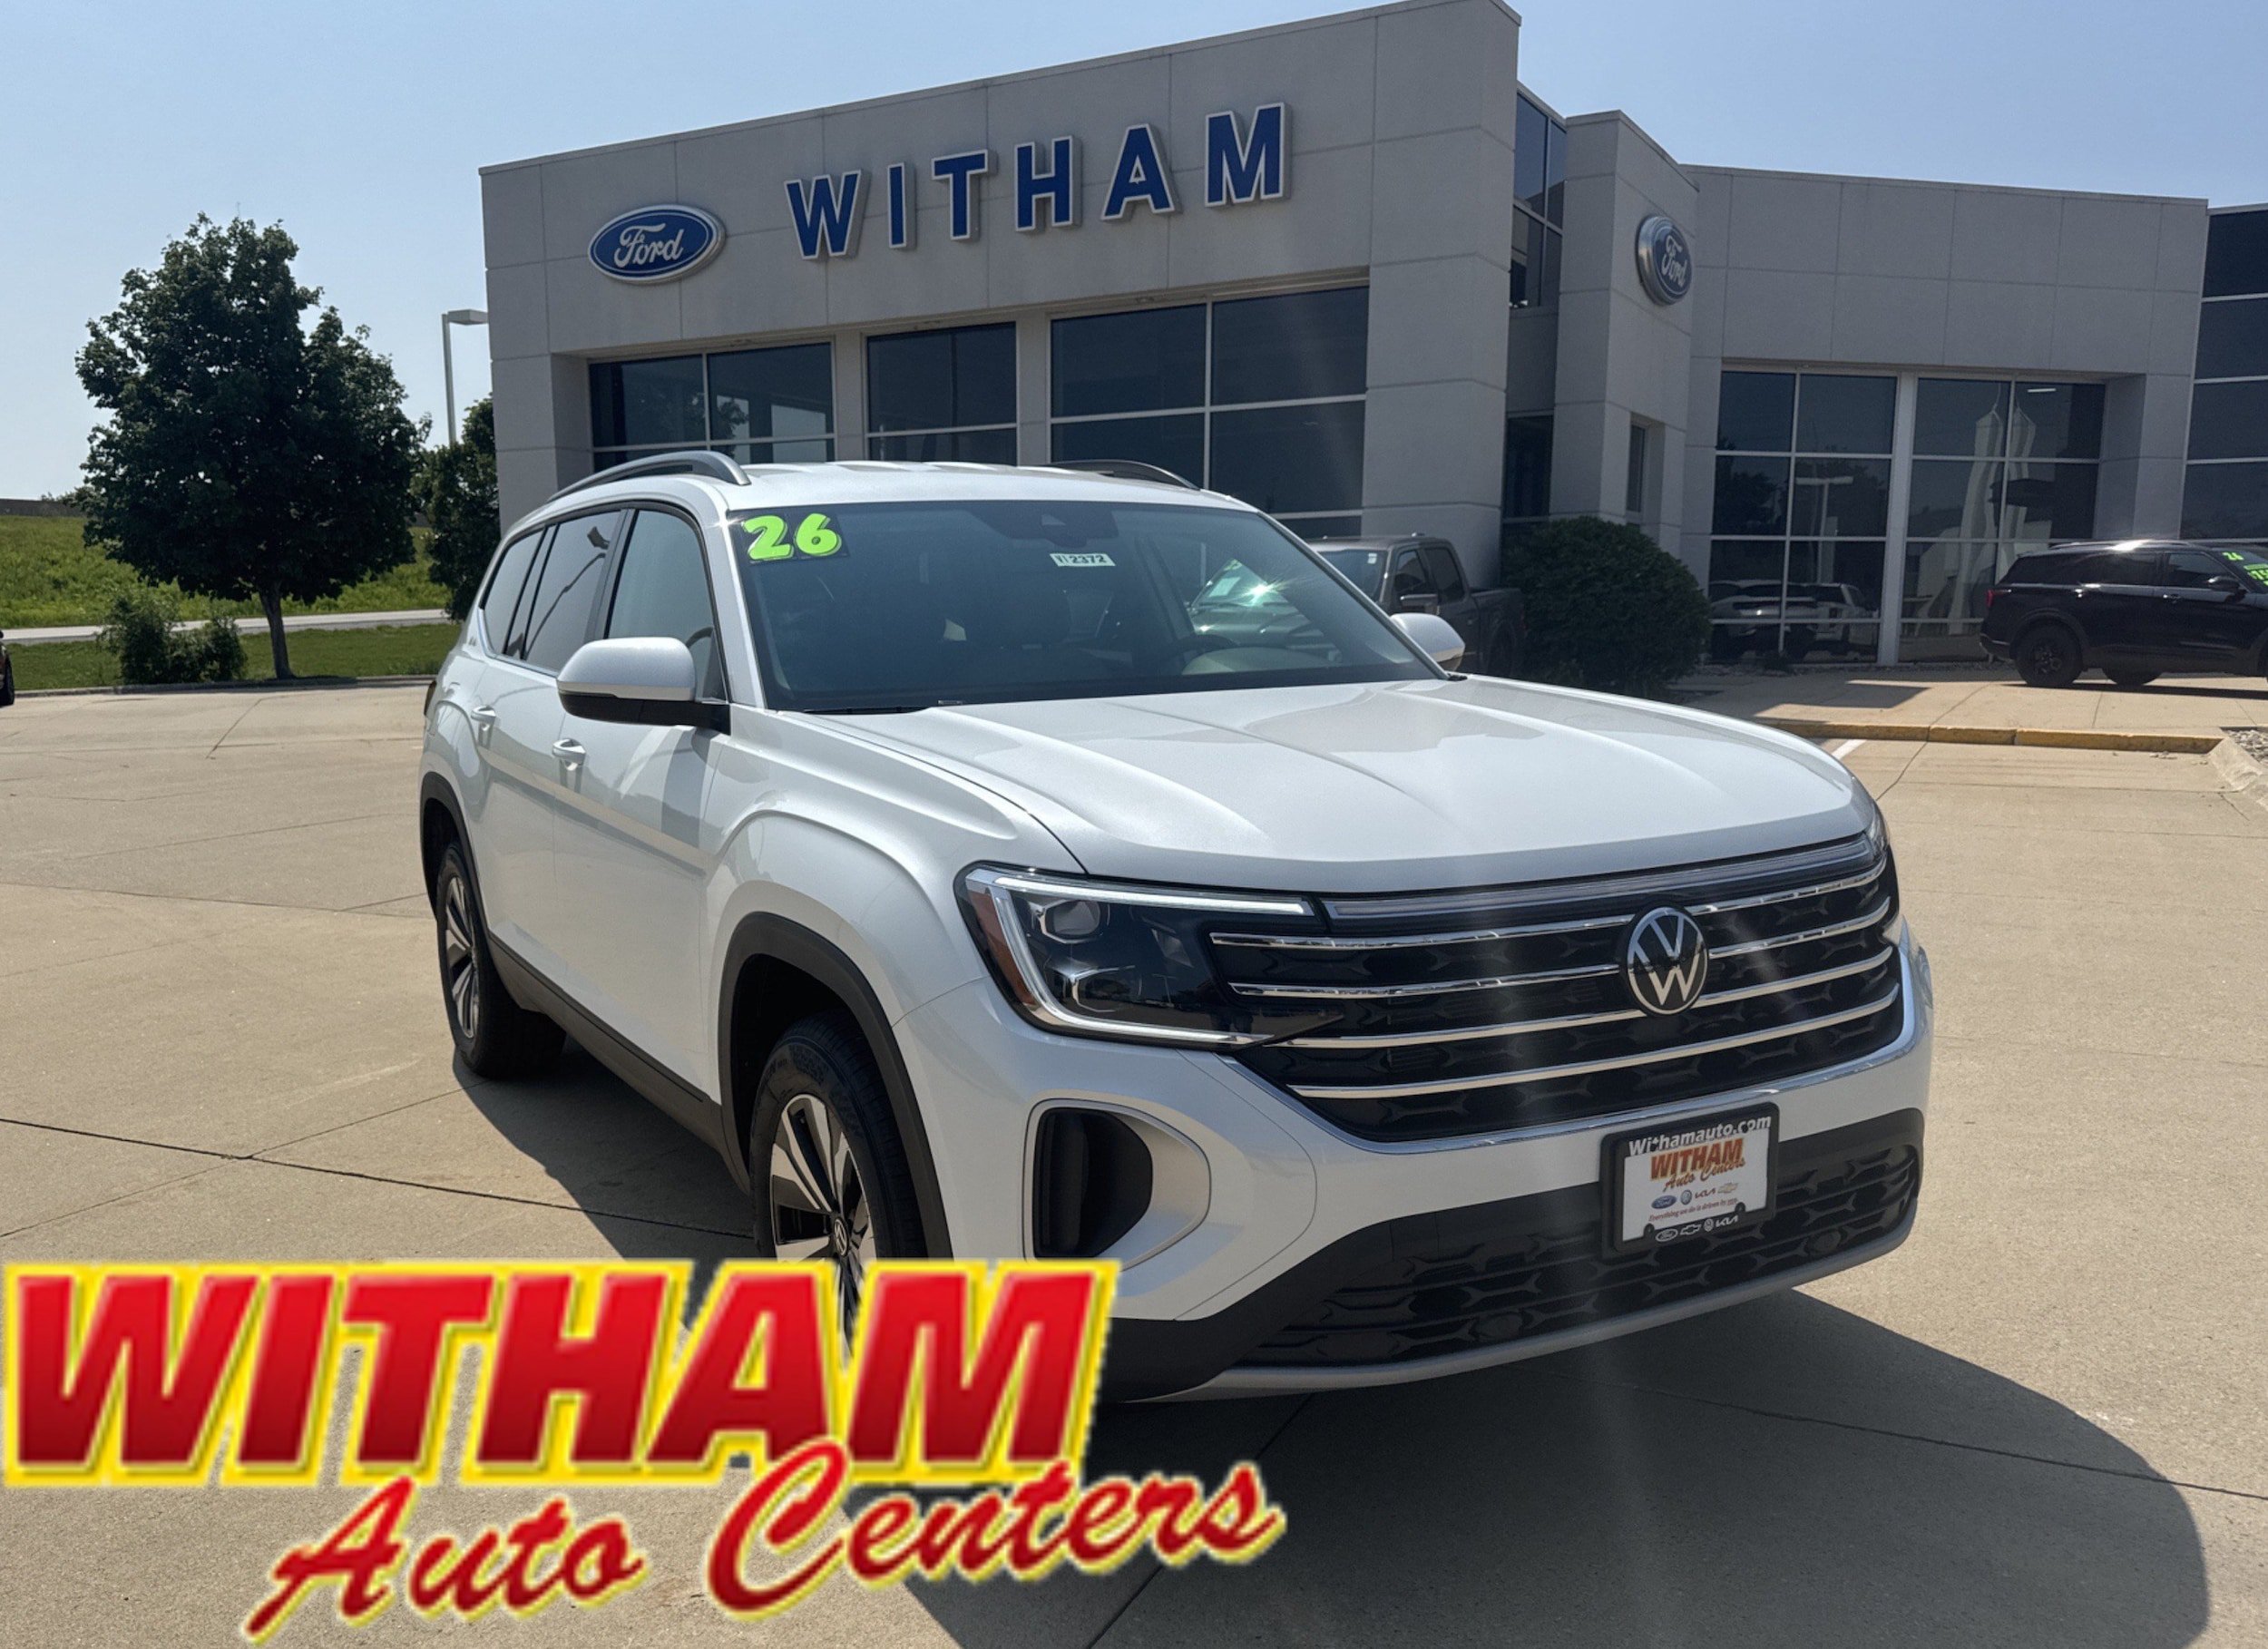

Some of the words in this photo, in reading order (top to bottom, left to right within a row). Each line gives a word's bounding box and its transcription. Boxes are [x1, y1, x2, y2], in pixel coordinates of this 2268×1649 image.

[784, 102, 1288, 261] WITHAM
[614, 222, 684, 268] Ford
[1661, 234, 1687, 288] Ford
[740, 512, 841, 561] 26
[1650, 1138, 1744, 1180] WITHAM
[1663, 1171, 1696, 1193] Auto
[1700, 1157, 1746, 1182] Centers
